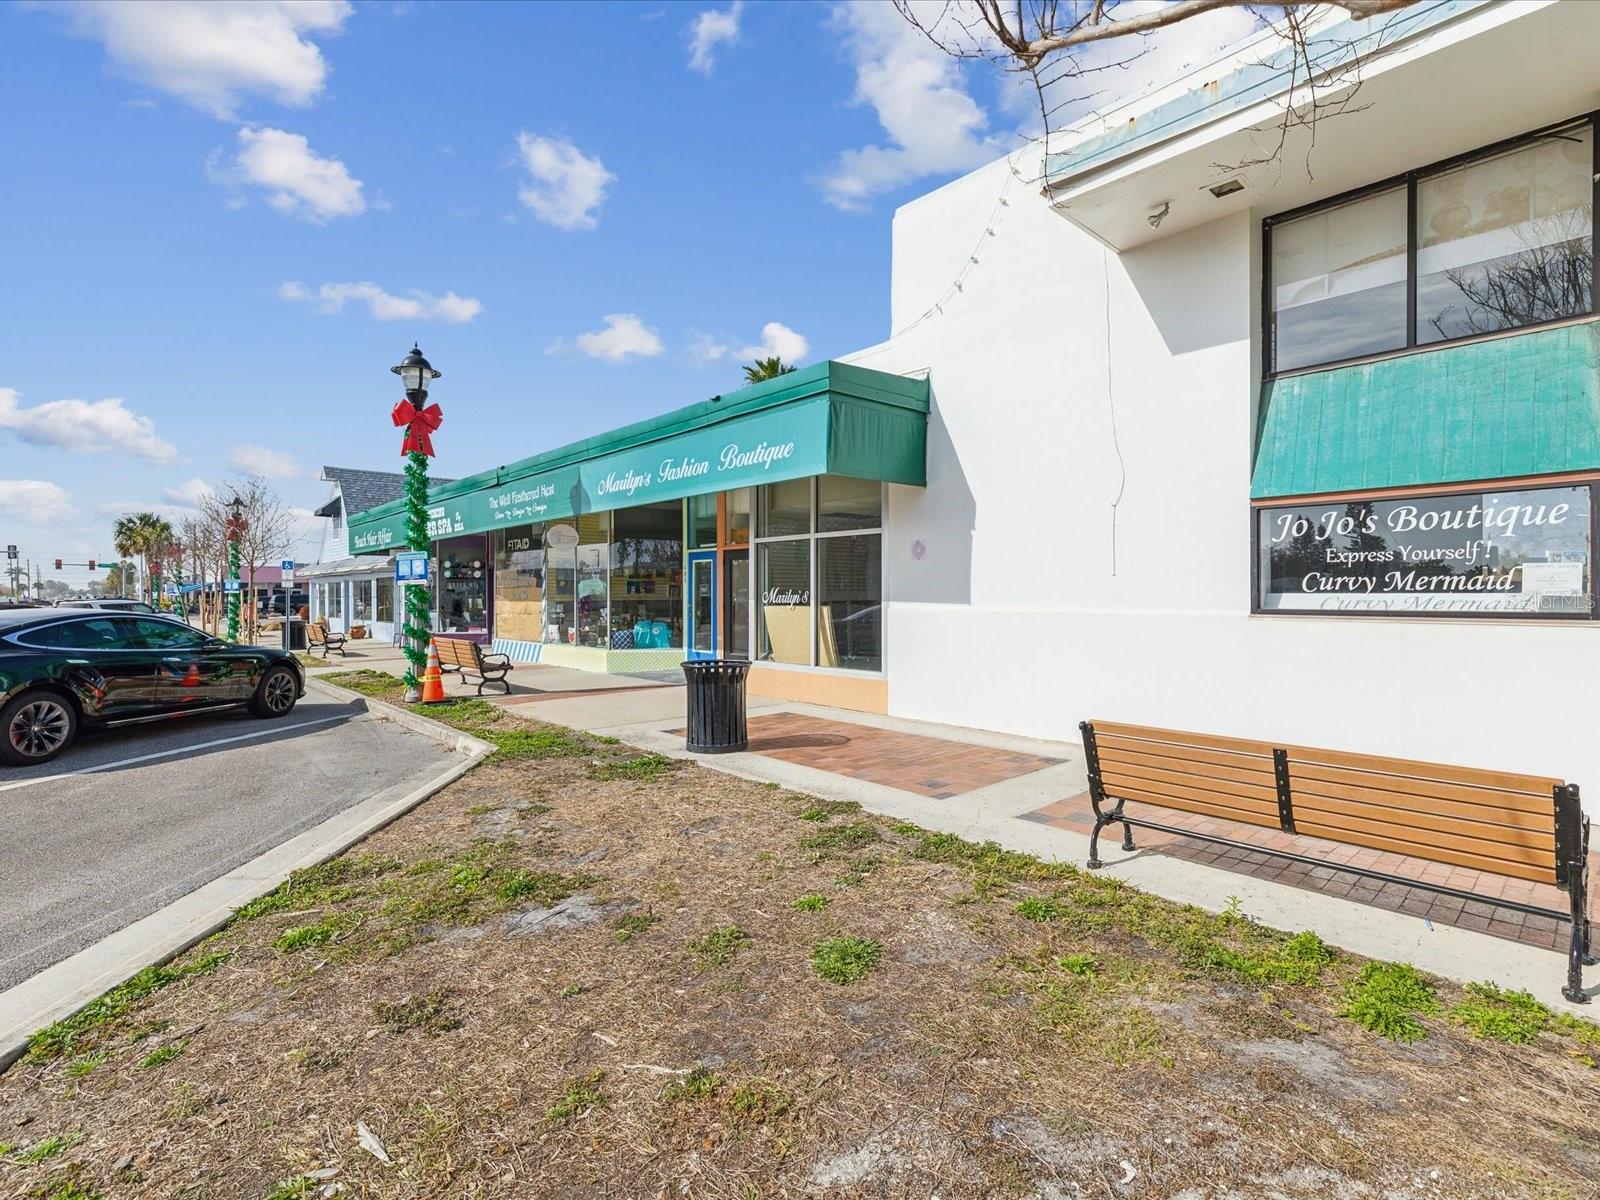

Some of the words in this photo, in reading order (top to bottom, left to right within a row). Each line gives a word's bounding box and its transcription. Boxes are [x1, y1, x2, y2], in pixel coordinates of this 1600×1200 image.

[597, 469, 651, 496] Marilyn's
[658, 457, 710, 483] Fashion
[717, 441, 795, 471] Boutique
[437, 517, 453, 535] SPA
[1272, 514, 1309, 542] Jo
[1315, 509, 1379, 541] Jo's
[1387, 498, 1570, 537] Boutique
[1325, 548, 1395, 568] Express
[1301, 571, 1377, 594] Curvy
[1383, 565, 1522, 594] Mermaid
